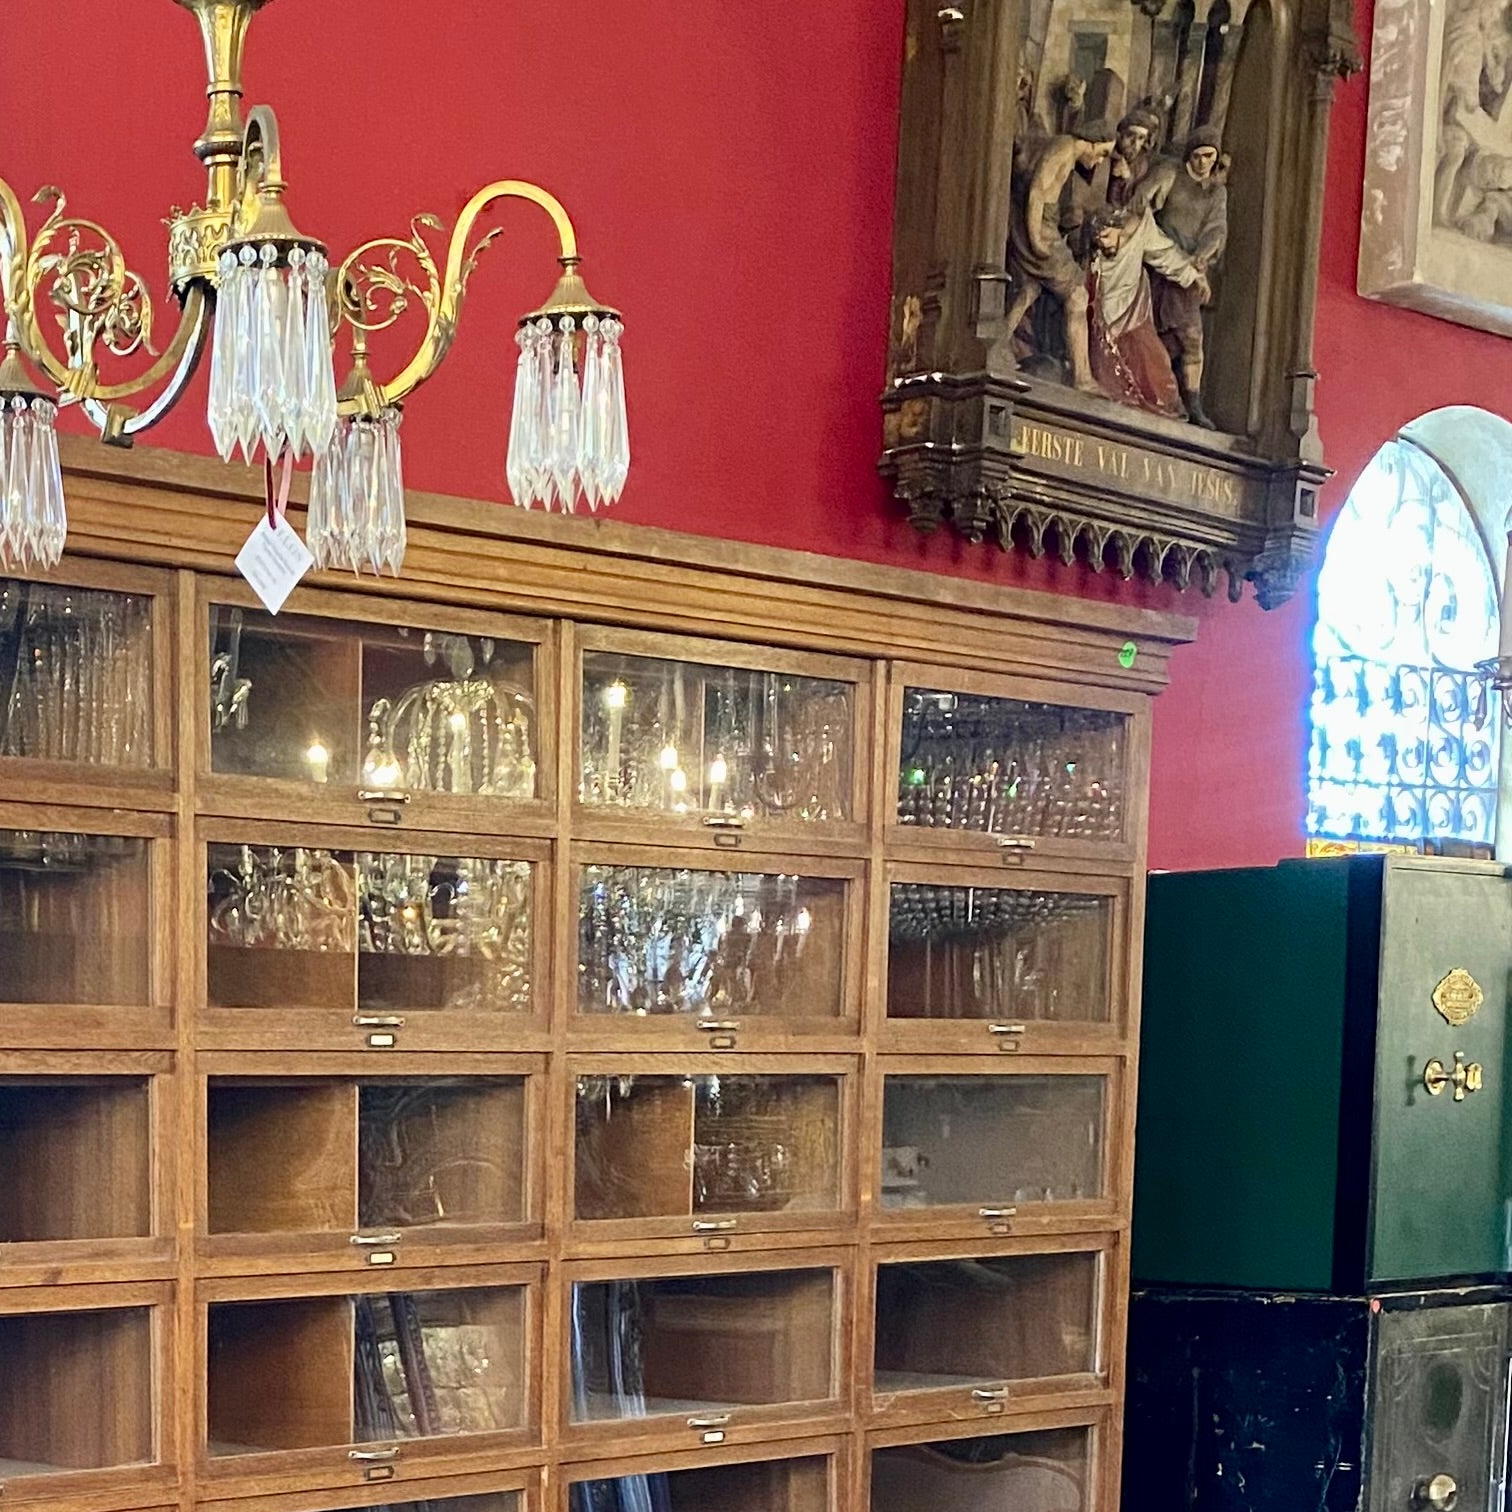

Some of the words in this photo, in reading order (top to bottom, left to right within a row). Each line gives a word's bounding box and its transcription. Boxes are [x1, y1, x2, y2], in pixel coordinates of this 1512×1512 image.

[1021, 425, 1083, 467] EERSTE
[1096, 445, 1129, 479] VAL
[1143, 456, 1177, 490] VAN
